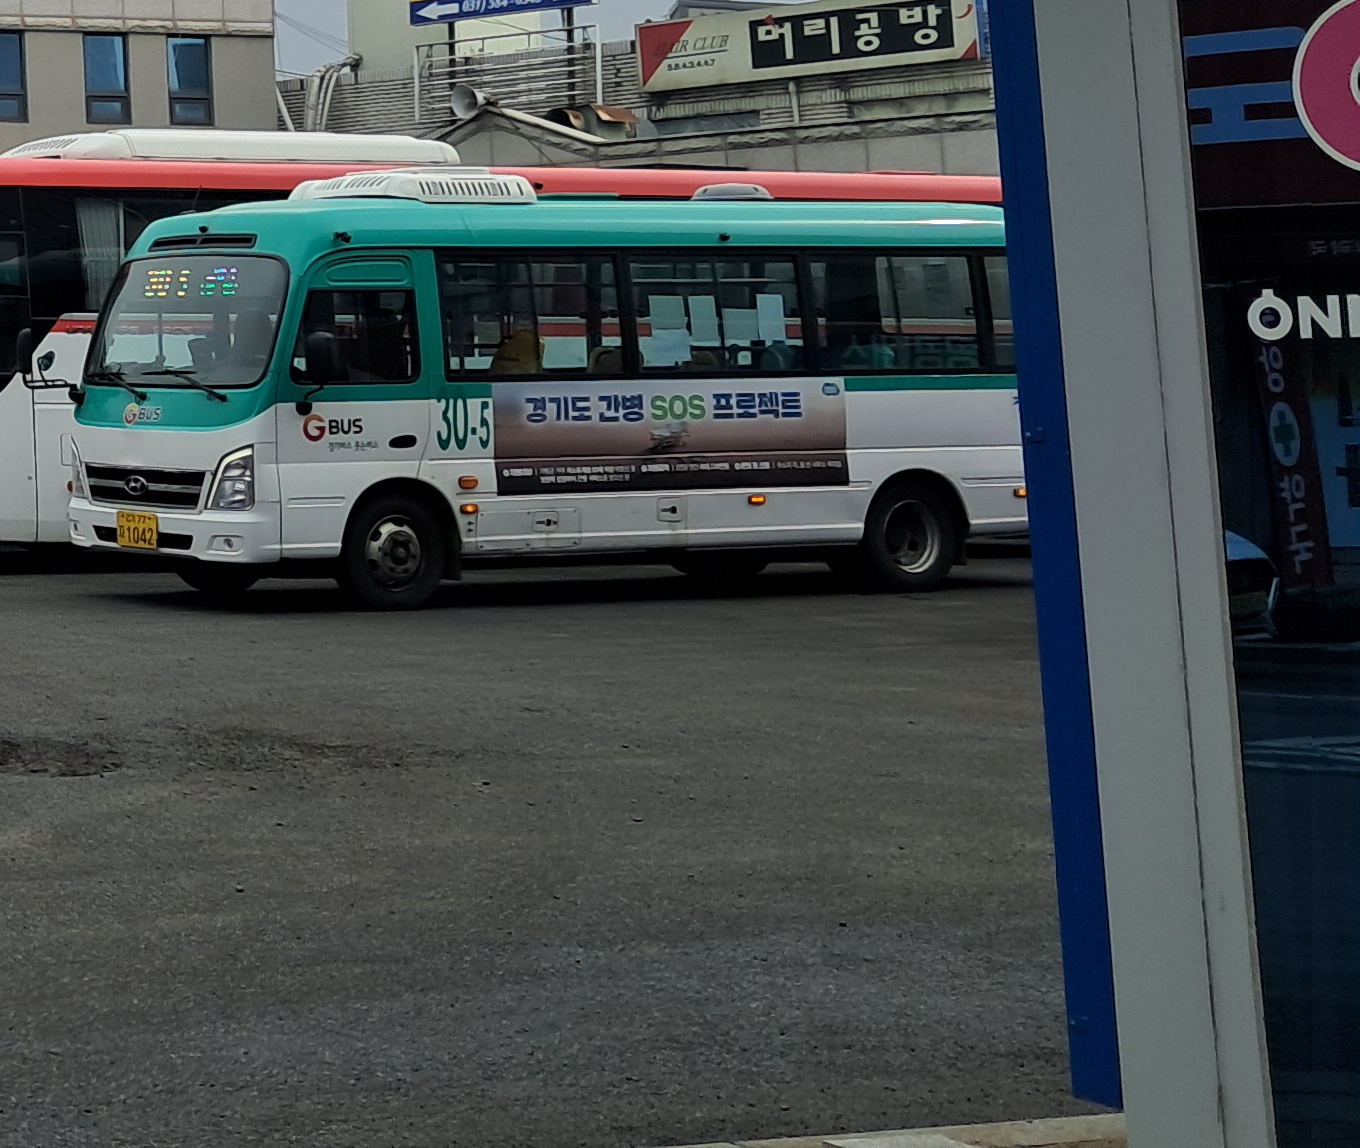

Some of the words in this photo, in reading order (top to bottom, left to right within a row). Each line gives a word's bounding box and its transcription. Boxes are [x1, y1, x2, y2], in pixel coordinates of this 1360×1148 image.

[757, 4, 943, 61] 머리공방
[435, 398, 491, 451] 30-5
[525, 395, 593, 424] 경기도
[597, 394, 645, 423] 간병
[650, 394, 706, 421] SOS
[712, 391, 803, 419] 프로젝트
